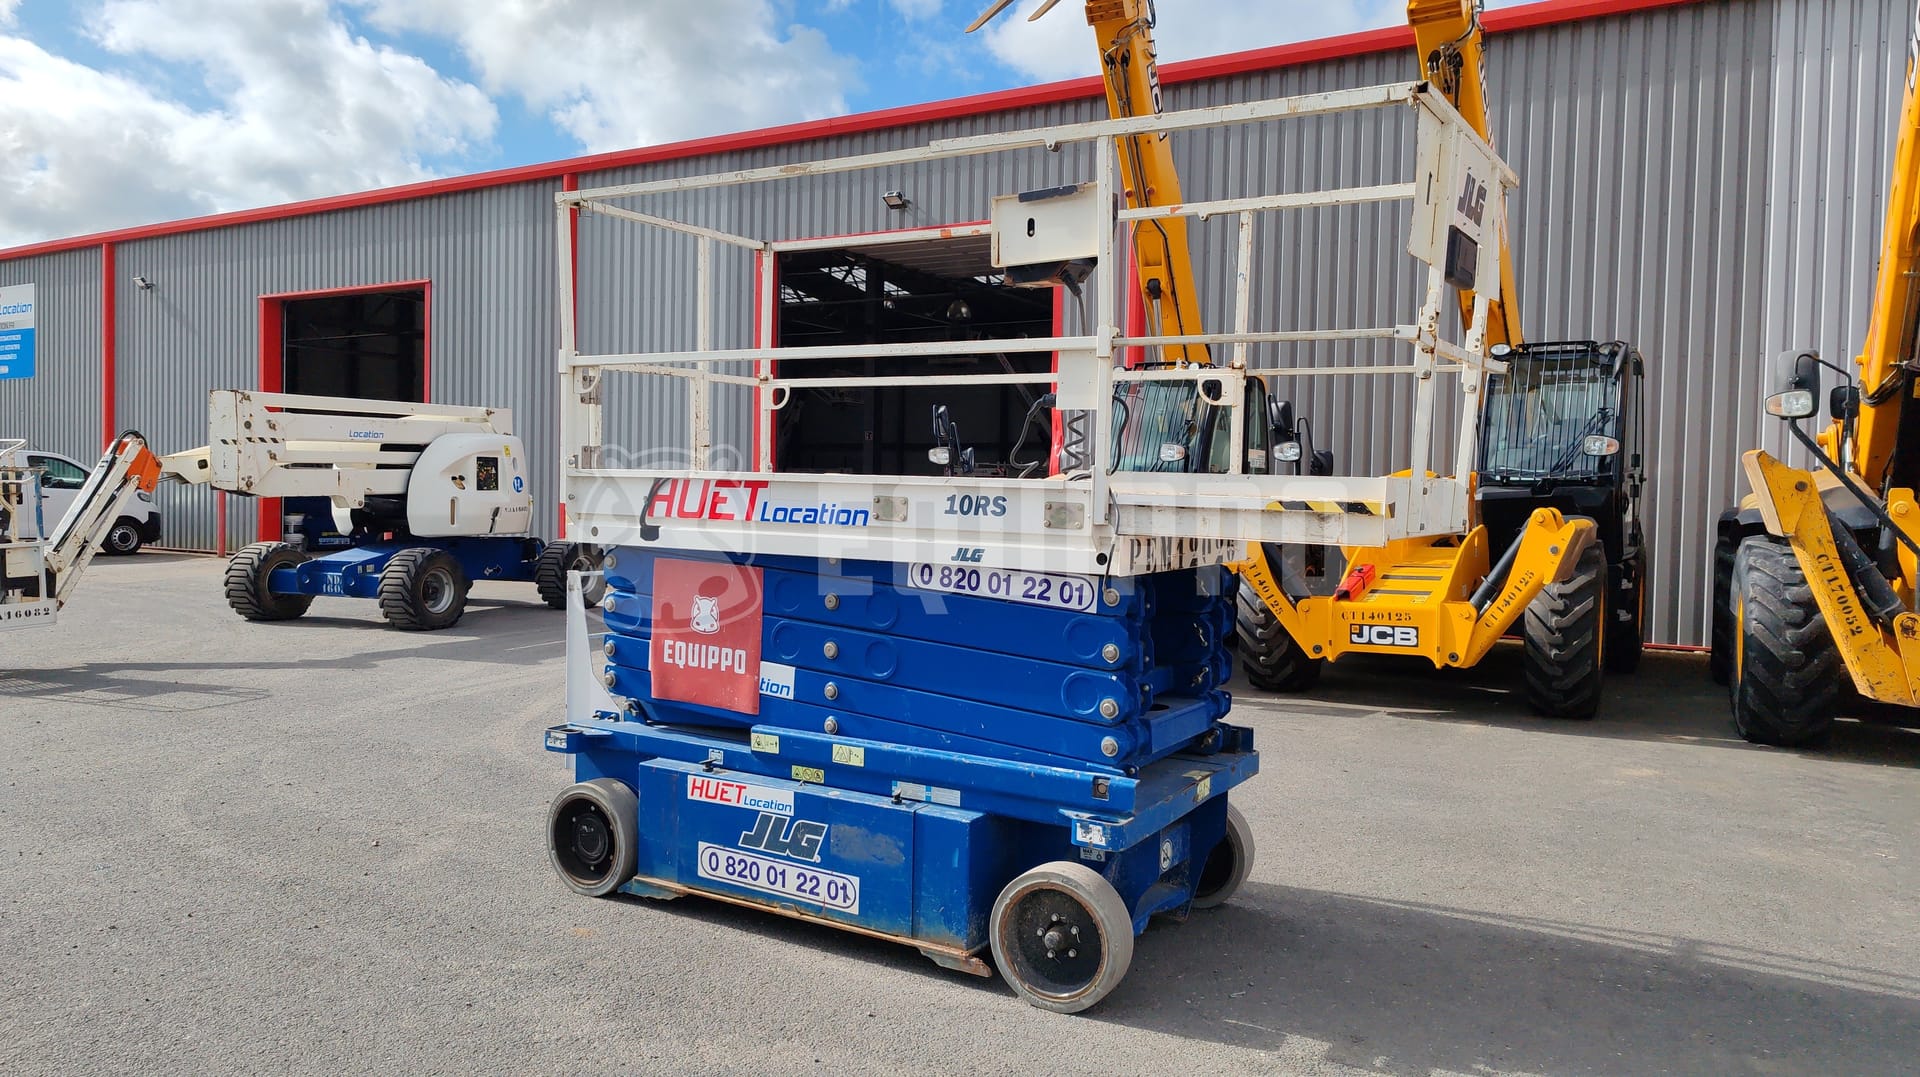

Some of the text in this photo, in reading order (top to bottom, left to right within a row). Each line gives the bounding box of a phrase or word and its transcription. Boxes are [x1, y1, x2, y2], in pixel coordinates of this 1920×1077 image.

[1457, 172, 1487, 228] JLG
[348, 429, 385, 440] Location
[647, 477, 869, 527] HUET Location
[944, 494, 1008, 517] 10RS
[951, 547, 986, 563] JLG
[326, 574, 343, 584] ND
[920, 563, 1085, 606] 0 820 01 22 01
[1816, 553, 1863, 636] CT170052
[1341, 611, 1412, 622] CT140125
[1351, 624, 1418, 646] JCB
[664, 639, 746, 674] EQUIPPO
[760, 677, 790, 697] tion
[690, 777, 792, 813] HUET Location
[738, 811, 829, 862] JLG
[708, 851, 850, 904] 0 820 01 22 01
